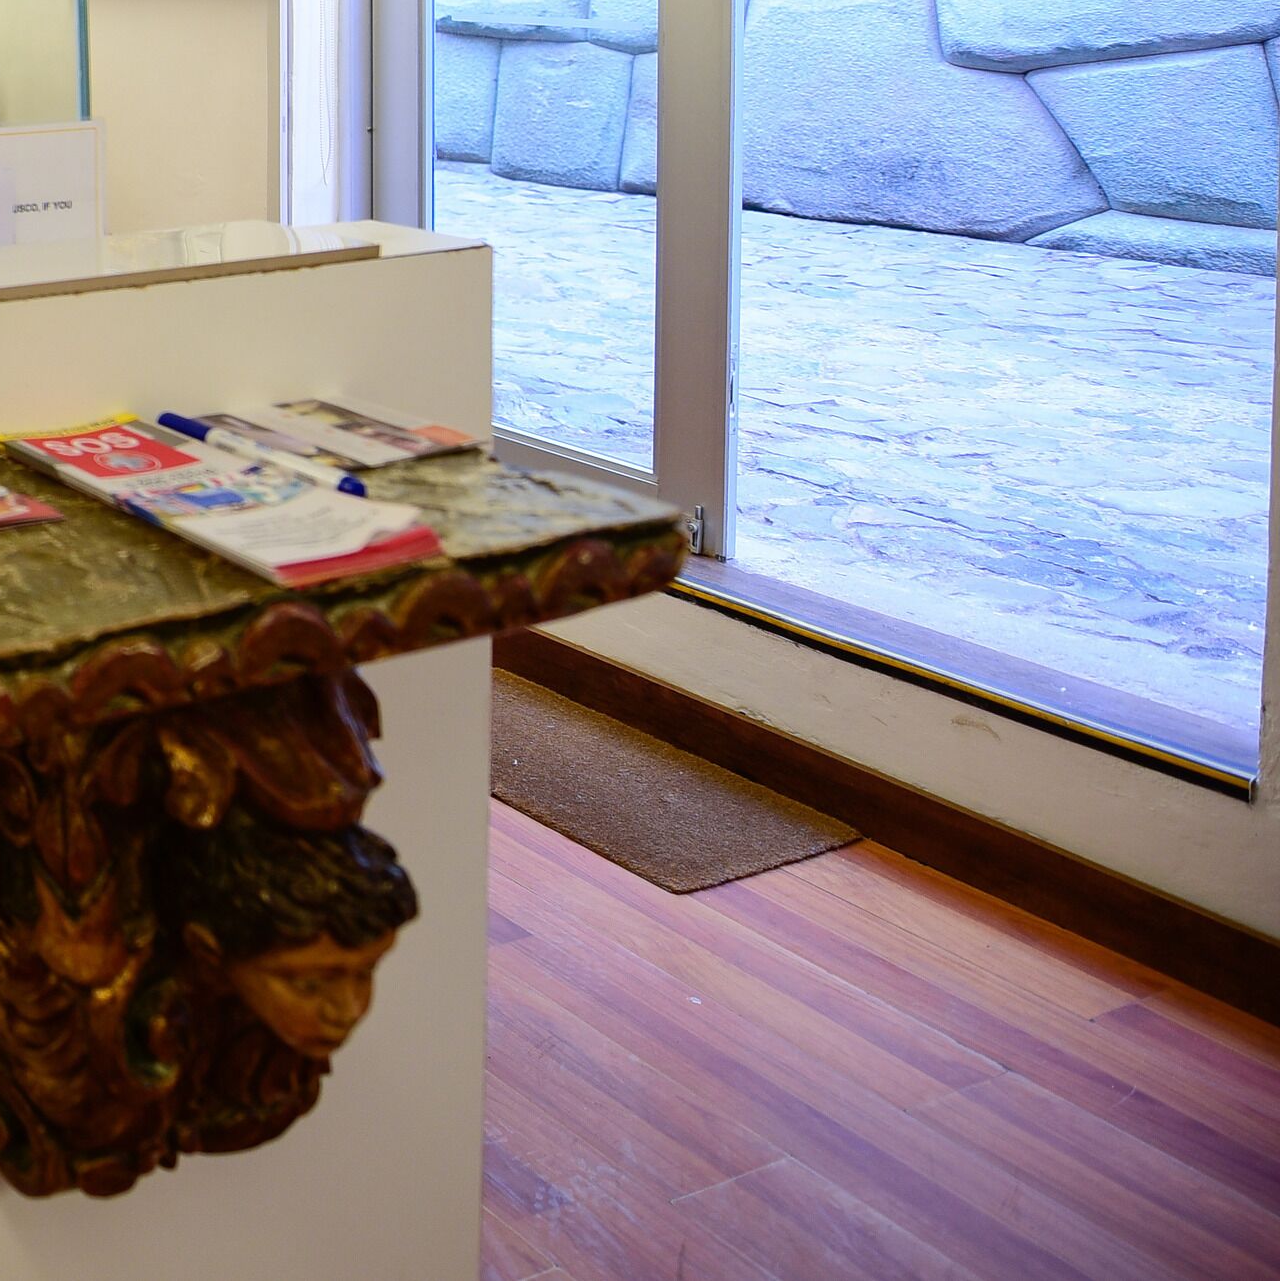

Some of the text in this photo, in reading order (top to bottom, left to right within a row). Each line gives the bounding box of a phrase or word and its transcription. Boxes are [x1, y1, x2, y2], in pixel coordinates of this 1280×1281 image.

[41, 201, 49, 211] IF
[52, 200, 73, 210] YOU
[42, 431, 140, 457] SOS
